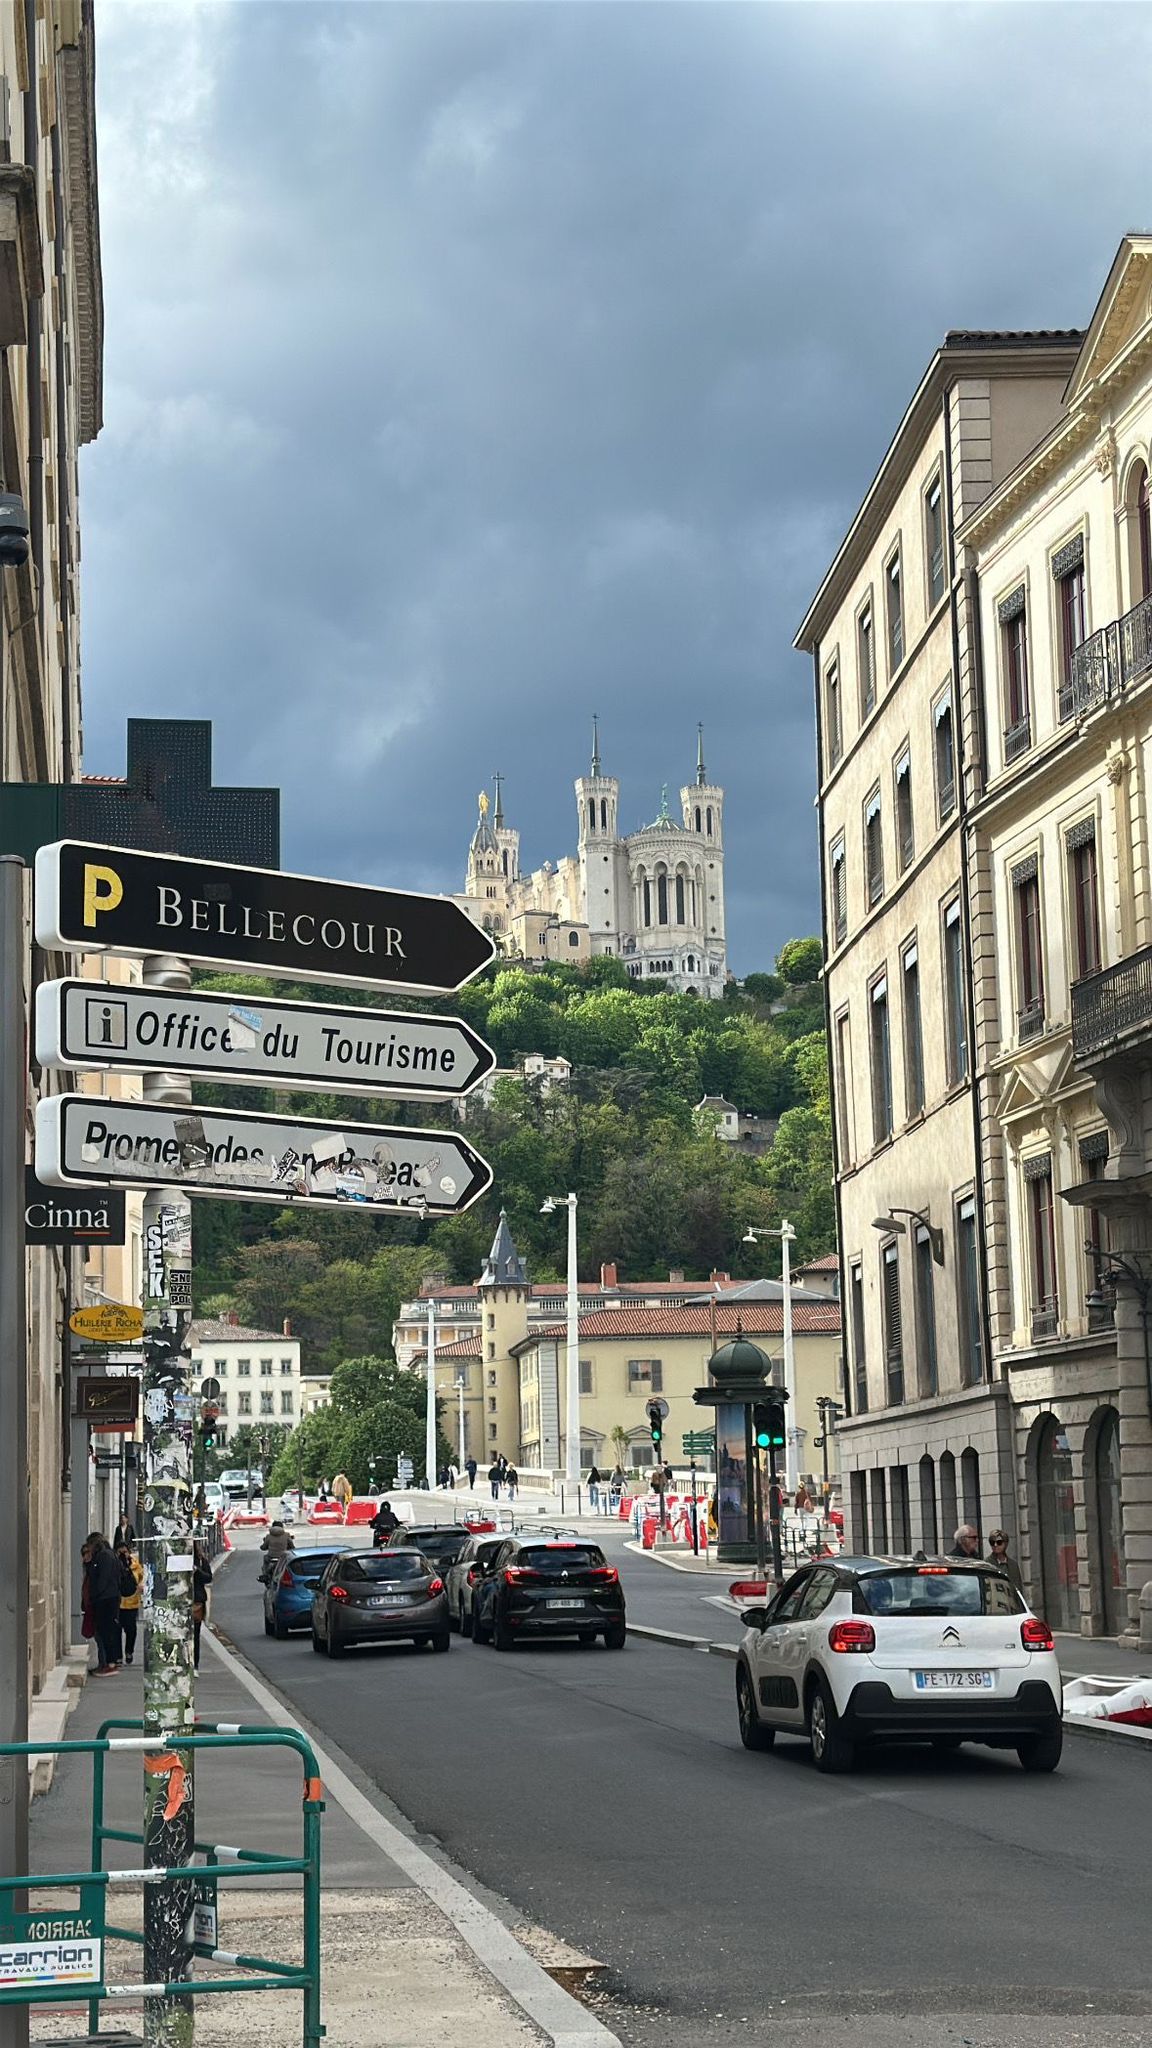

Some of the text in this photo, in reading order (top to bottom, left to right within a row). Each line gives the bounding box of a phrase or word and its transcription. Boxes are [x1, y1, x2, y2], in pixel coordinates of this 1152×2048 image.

[156, 885, 408, 958] BELLECOUR
[136, 1011, 234, 1053] Office
[263, 1024, 299, 1059] du
[321, 1027, 455, 1072] Tourisme
[24, 1200, 110, 1228] Cinna
[148, 1226, 164, 1298] SEK
[115, 1317, 143, 1328] RICHA
[0, 1946, 93, 1967] carrion
